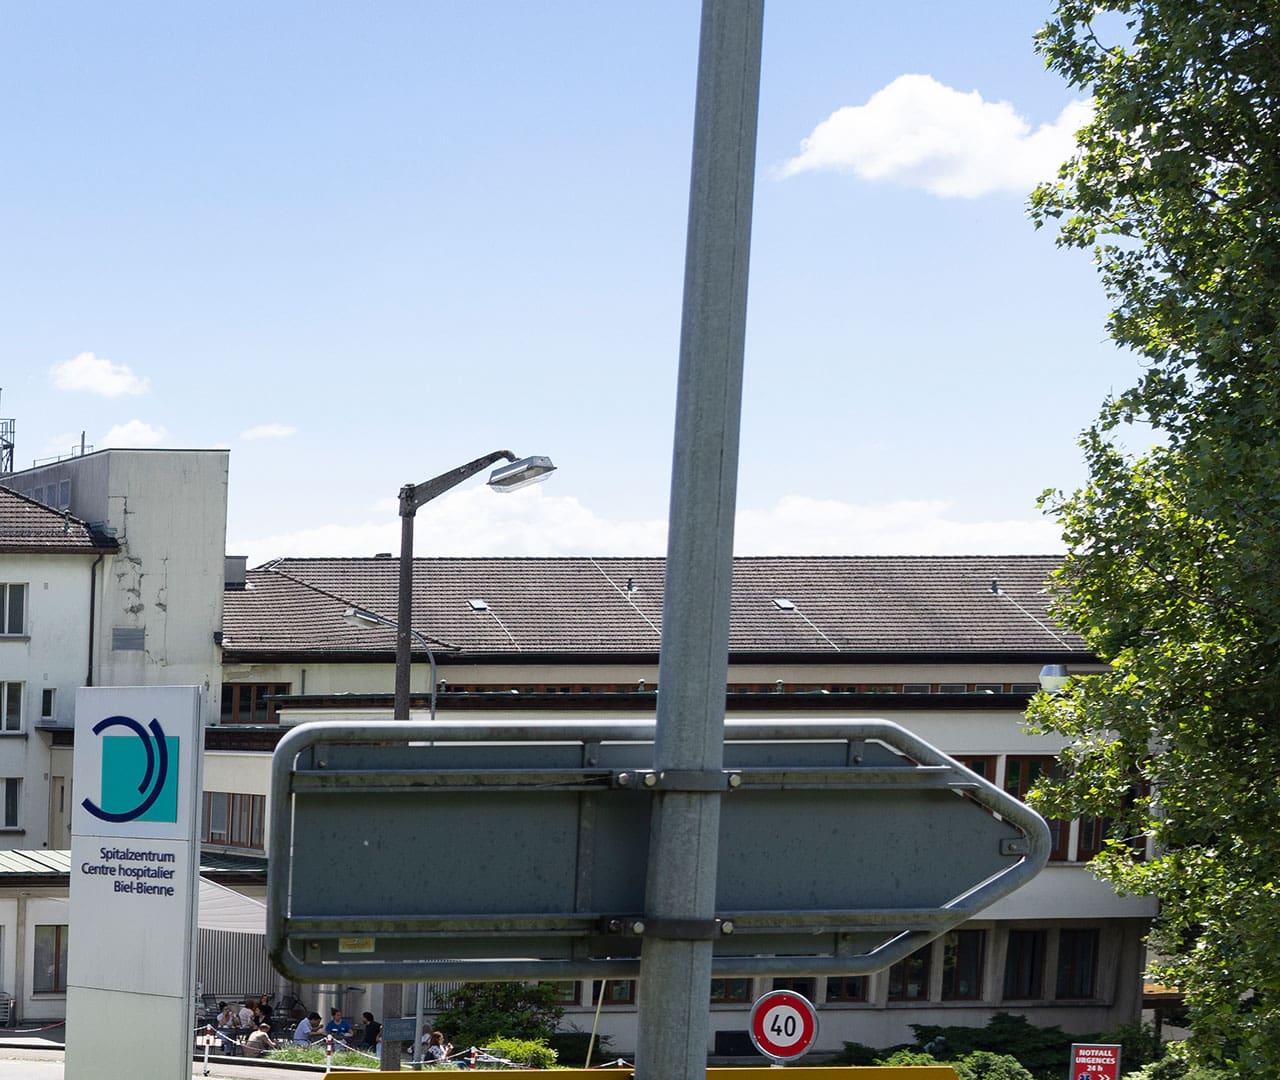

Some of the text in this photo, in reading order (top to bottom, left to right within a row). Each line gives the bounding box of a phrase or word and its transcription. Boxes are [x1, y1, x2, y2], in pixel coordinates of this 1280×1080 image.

[100, 847, 175, 863] Spitalzentrum
[81, 863, 175, 880] Centre hospitalier
[114, 880, 174, 896] Biel-Bienne
[770, 1014, 796, 1037] 40
